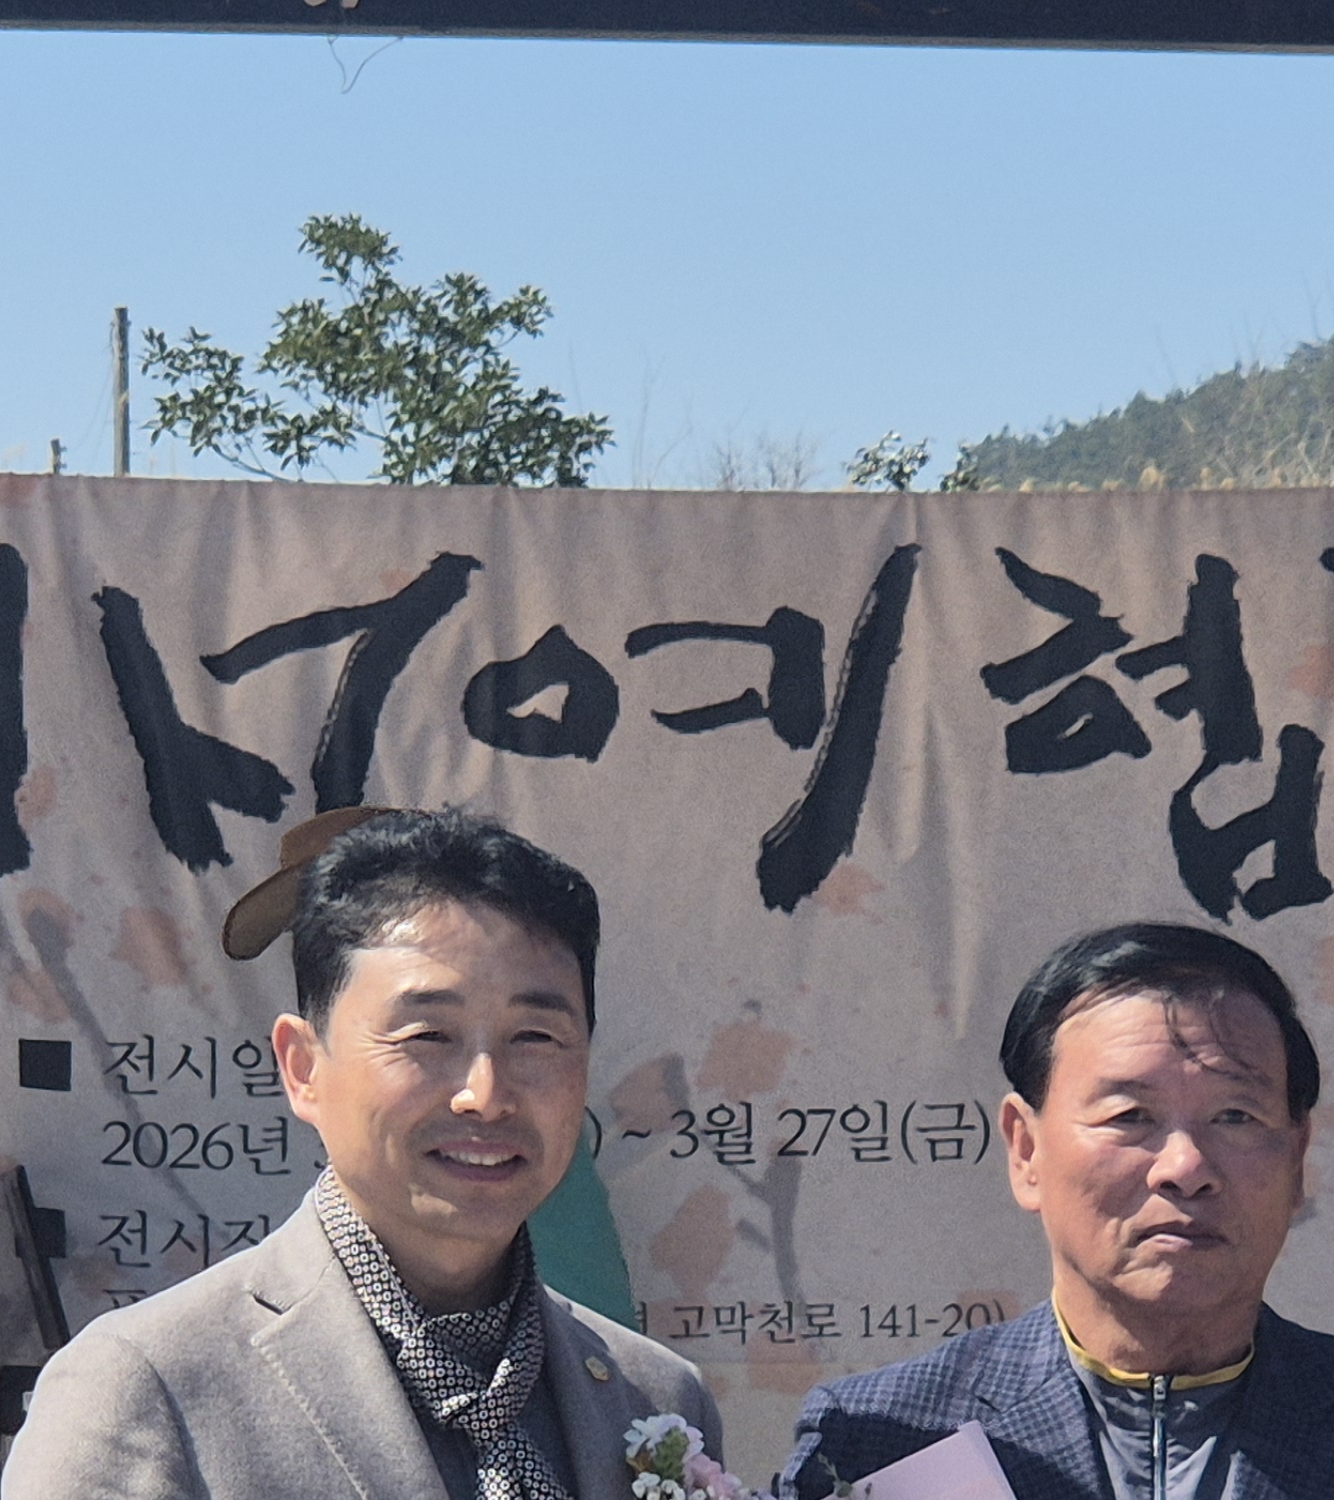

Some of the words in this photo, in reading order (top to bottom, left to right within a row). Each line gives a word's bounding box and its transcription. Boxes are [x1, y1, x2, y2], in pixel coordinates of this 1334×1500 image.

[102, 1116, 291, 1175] 2026년
[669, 1101, 756, 1165] 3월
[777, 1101, 991, 1164] 27일(금)
[669, 1302, 843, 1345] 고막천로
